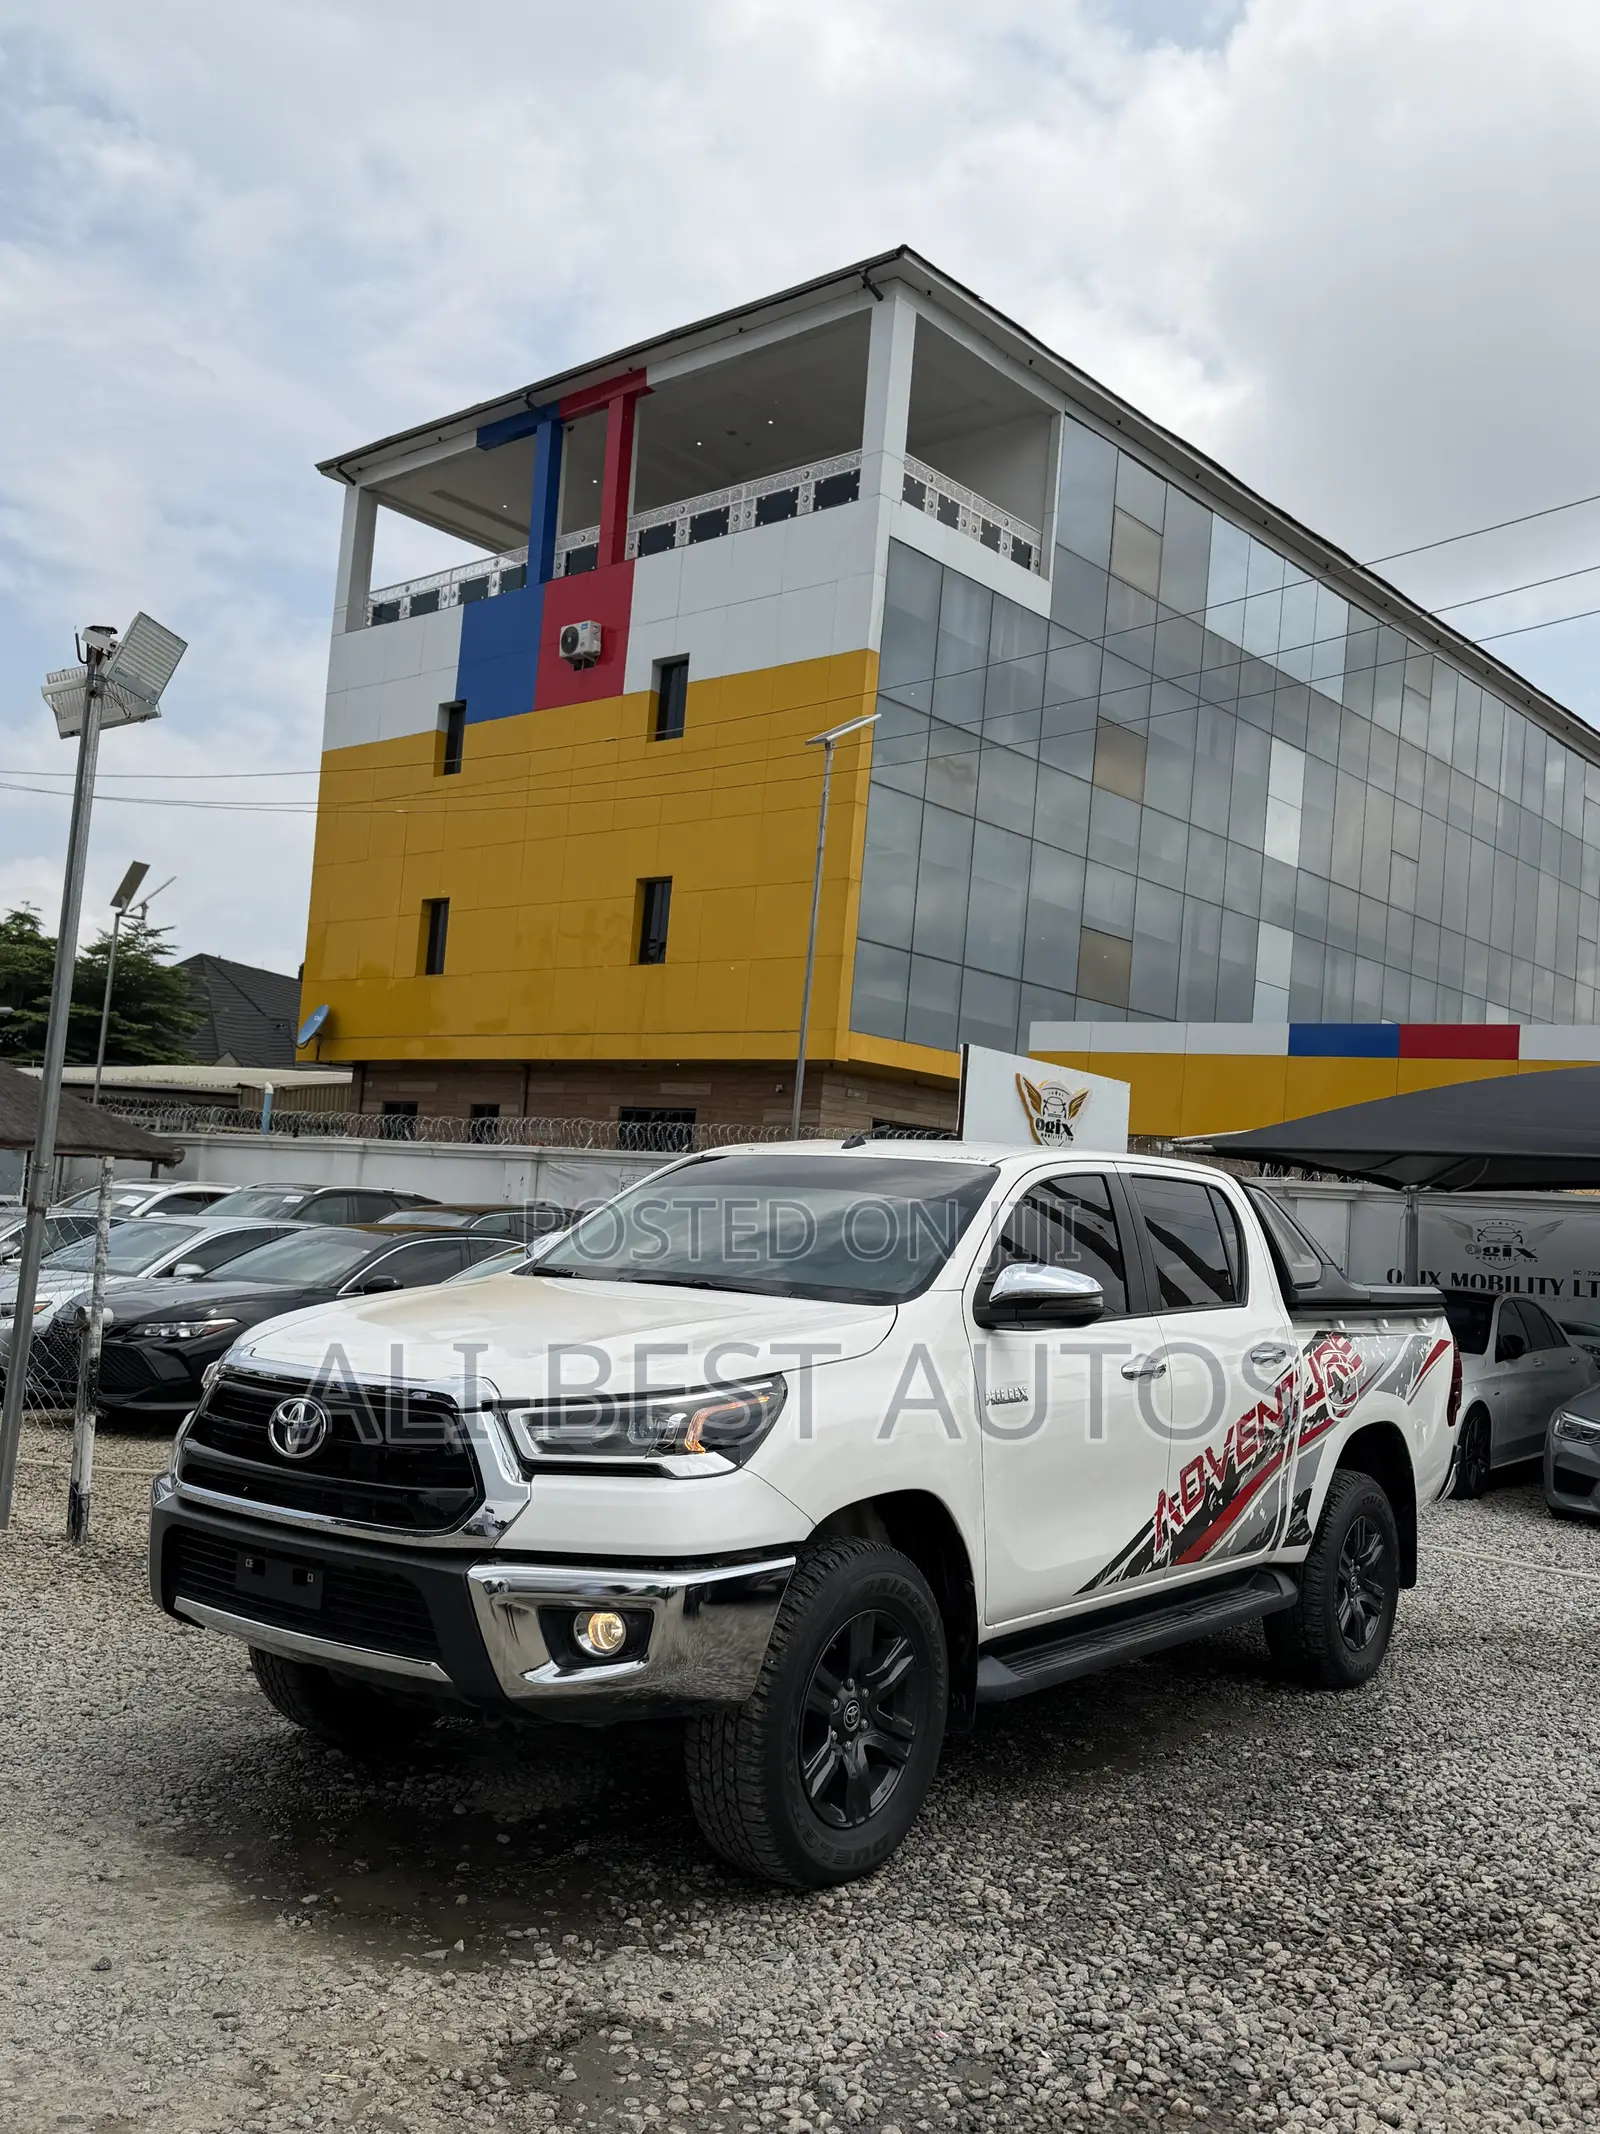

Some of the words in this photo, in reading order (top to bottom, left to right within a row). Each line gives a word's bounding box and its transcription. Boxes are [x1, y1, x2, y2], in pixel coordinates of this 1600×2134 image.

[1035, 1117, 1074, 1137] Ogix
[1386, 1268, 1442, 1286] OIX
[1451, 1271, 1565, 1297] MOBILITY
[1573, 1279, 1600, 1299] LT
[1154, 1331, 1365, 1553] ADVENTURE
